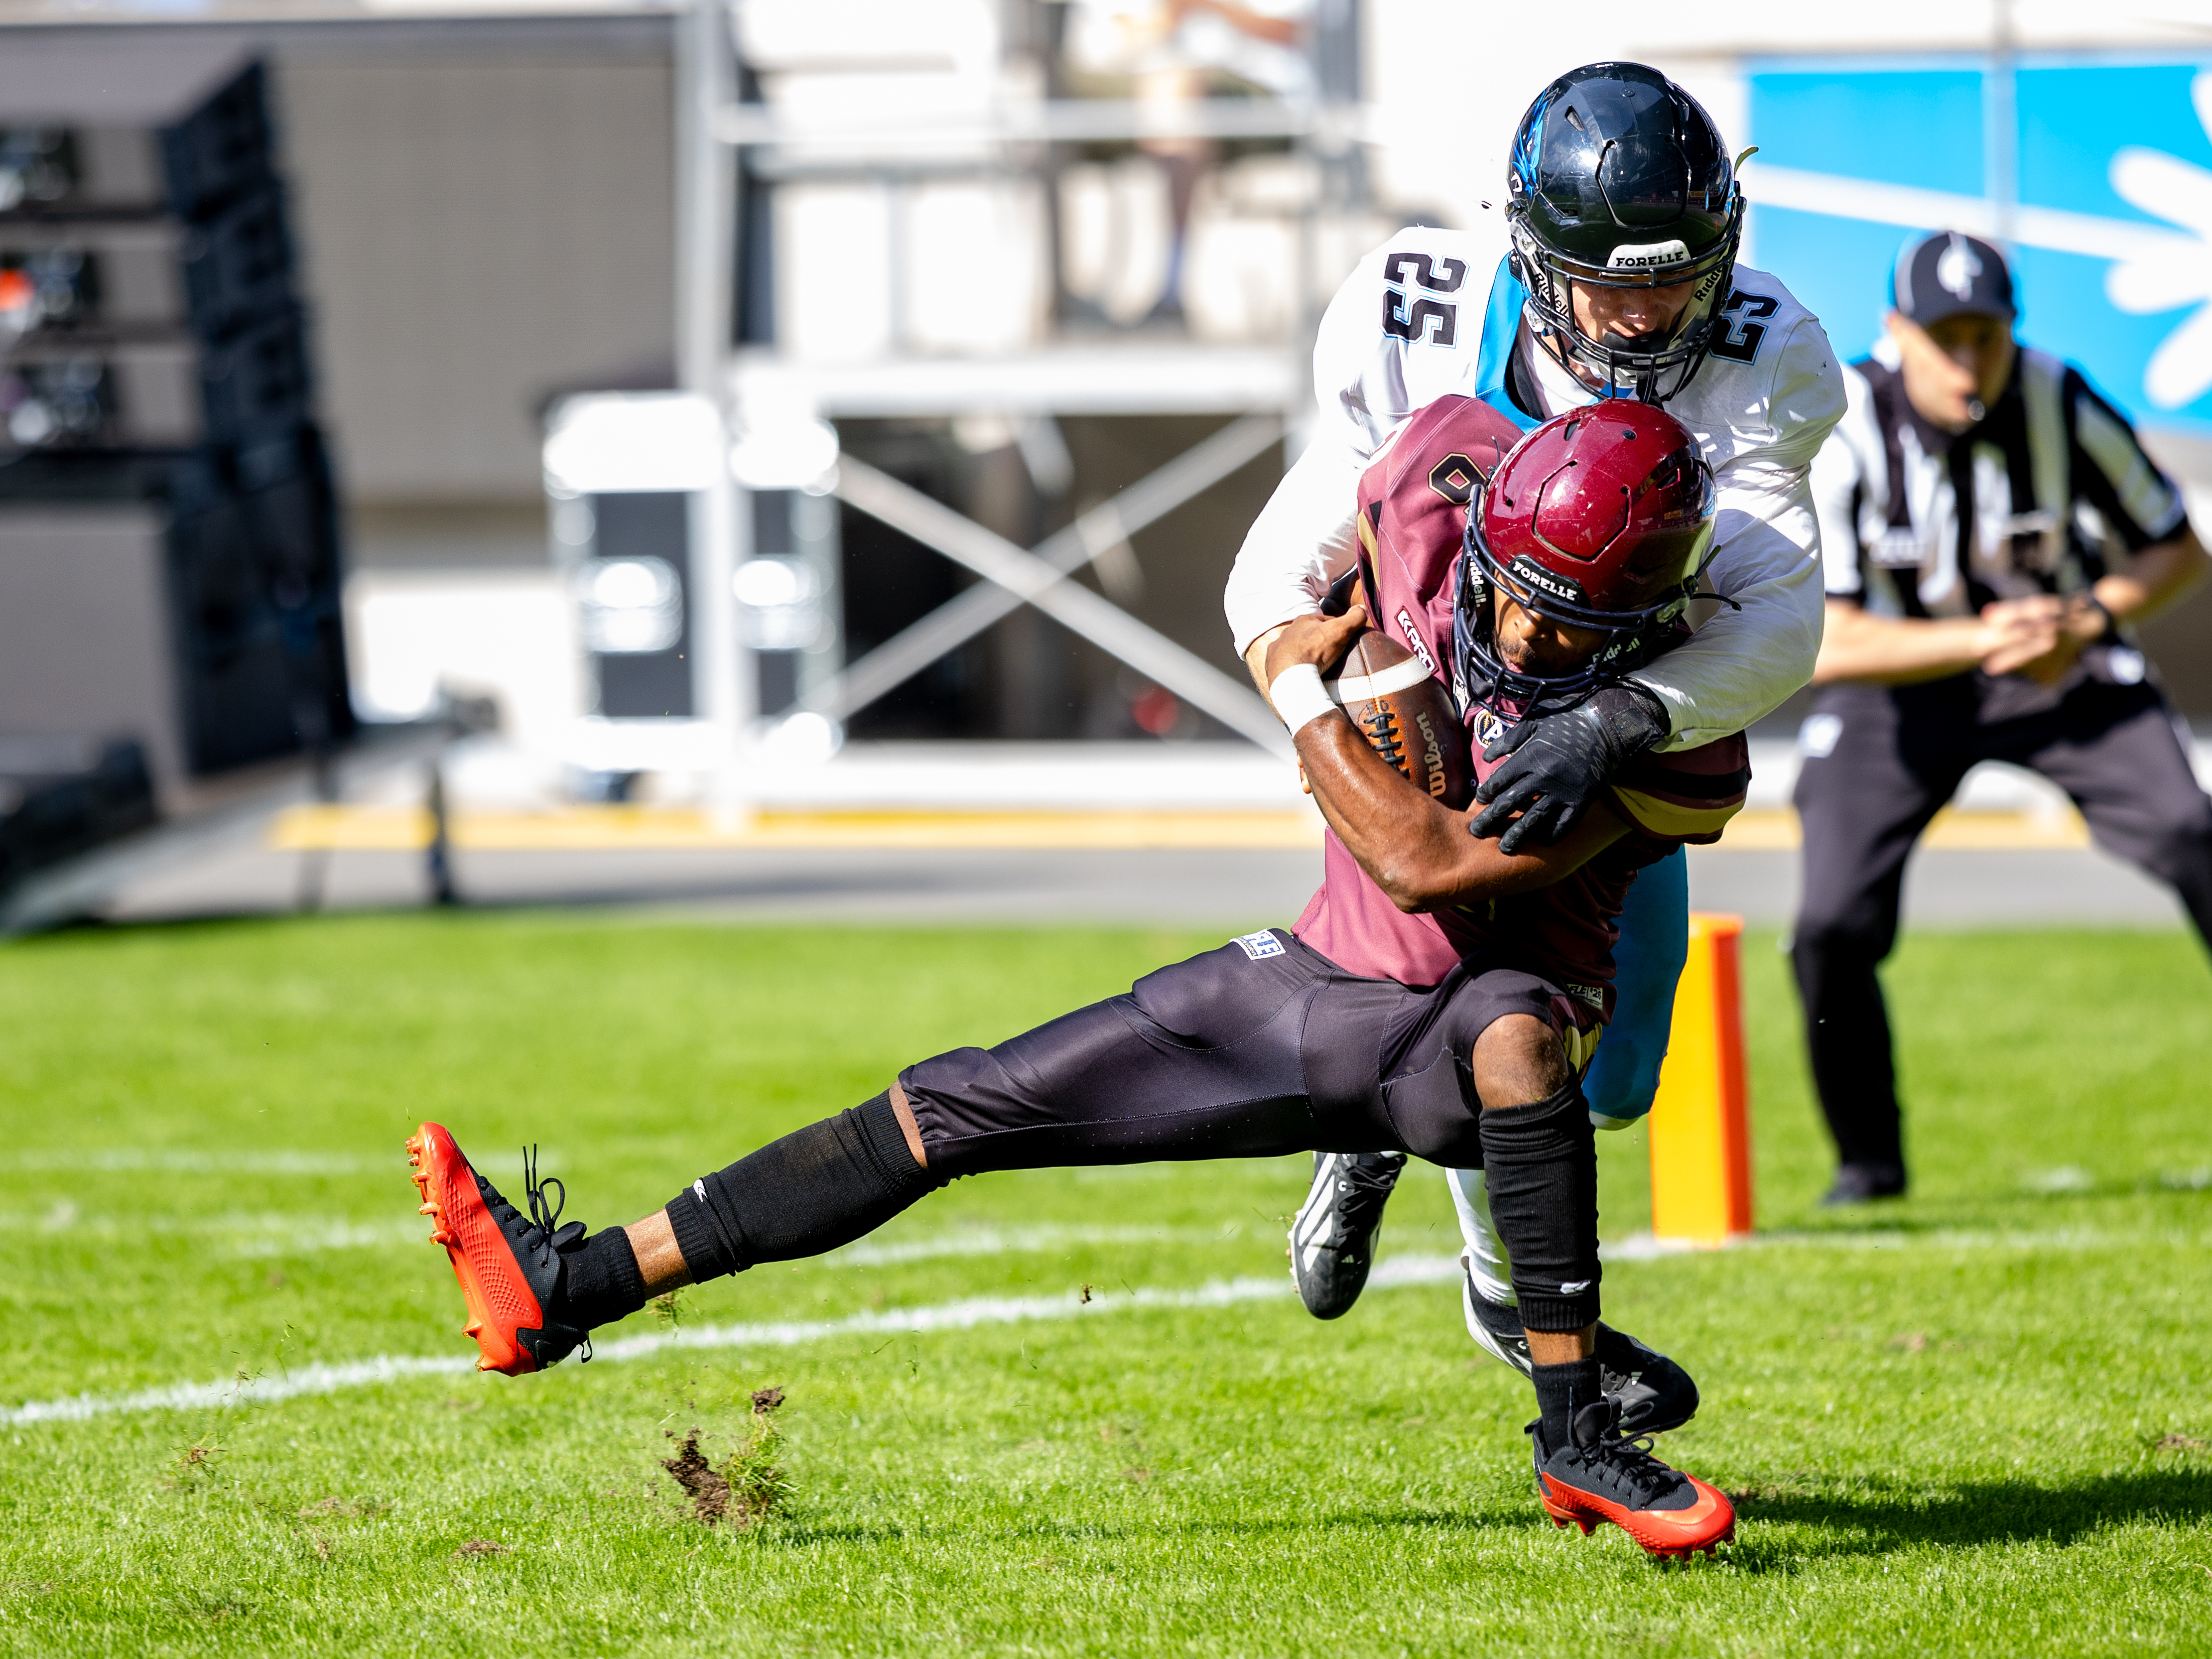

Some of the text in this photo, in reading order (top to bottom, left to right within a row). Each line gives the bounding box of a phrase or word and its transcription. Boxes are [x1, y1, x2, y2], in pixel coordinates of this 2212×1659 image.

[1616, 251, 1684, 267] FORELLE
[1380, 251, 1469, 349] 25
[1513, 561, 1577, 601] FORELLE
[1416, 711, 1446, 797] Wilson
